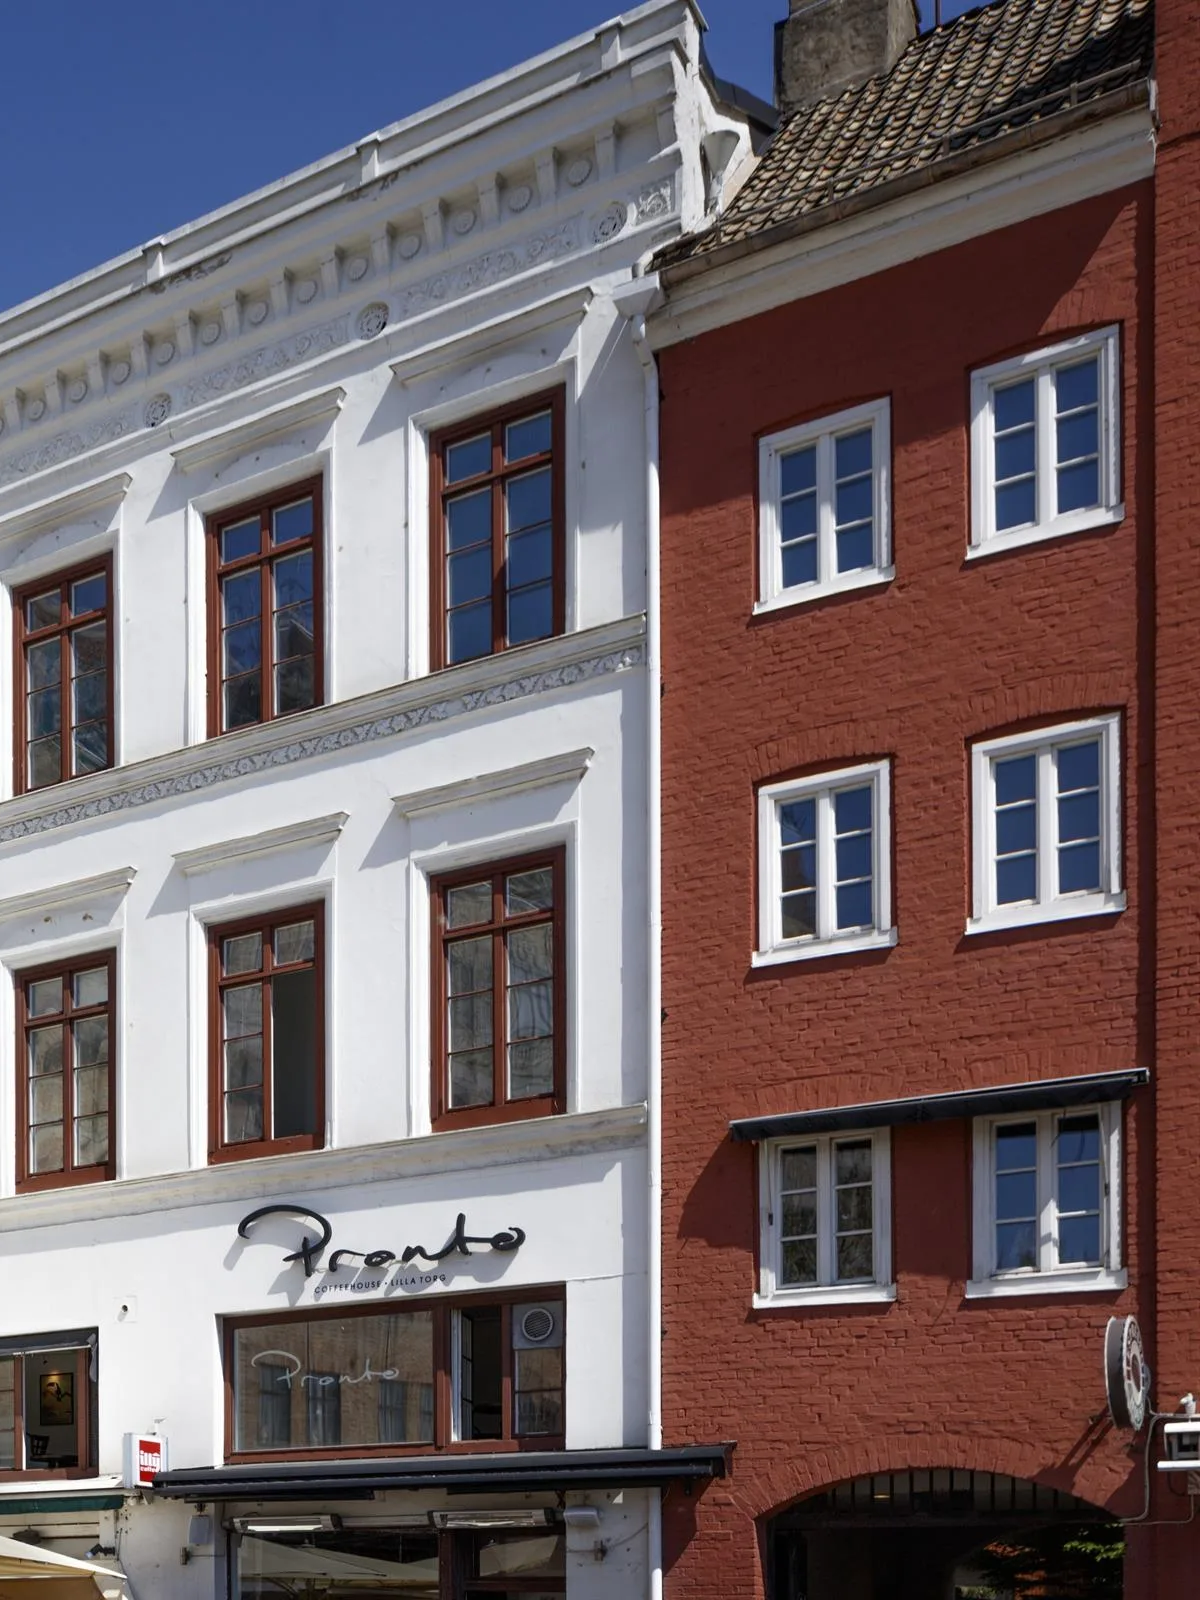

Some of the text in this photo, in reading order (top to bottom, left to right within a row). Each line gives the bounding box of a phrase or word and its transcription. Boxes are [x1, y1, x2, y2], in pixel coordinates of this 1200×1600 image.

[238, 1205, 525, 1277] Pronto
[314, 1273, 446, 1294] COFFEEHOUSE LILLA TORG
[251, 1350, 399, 1388] Pronto
[139, 1450, 161, 1472] illy
